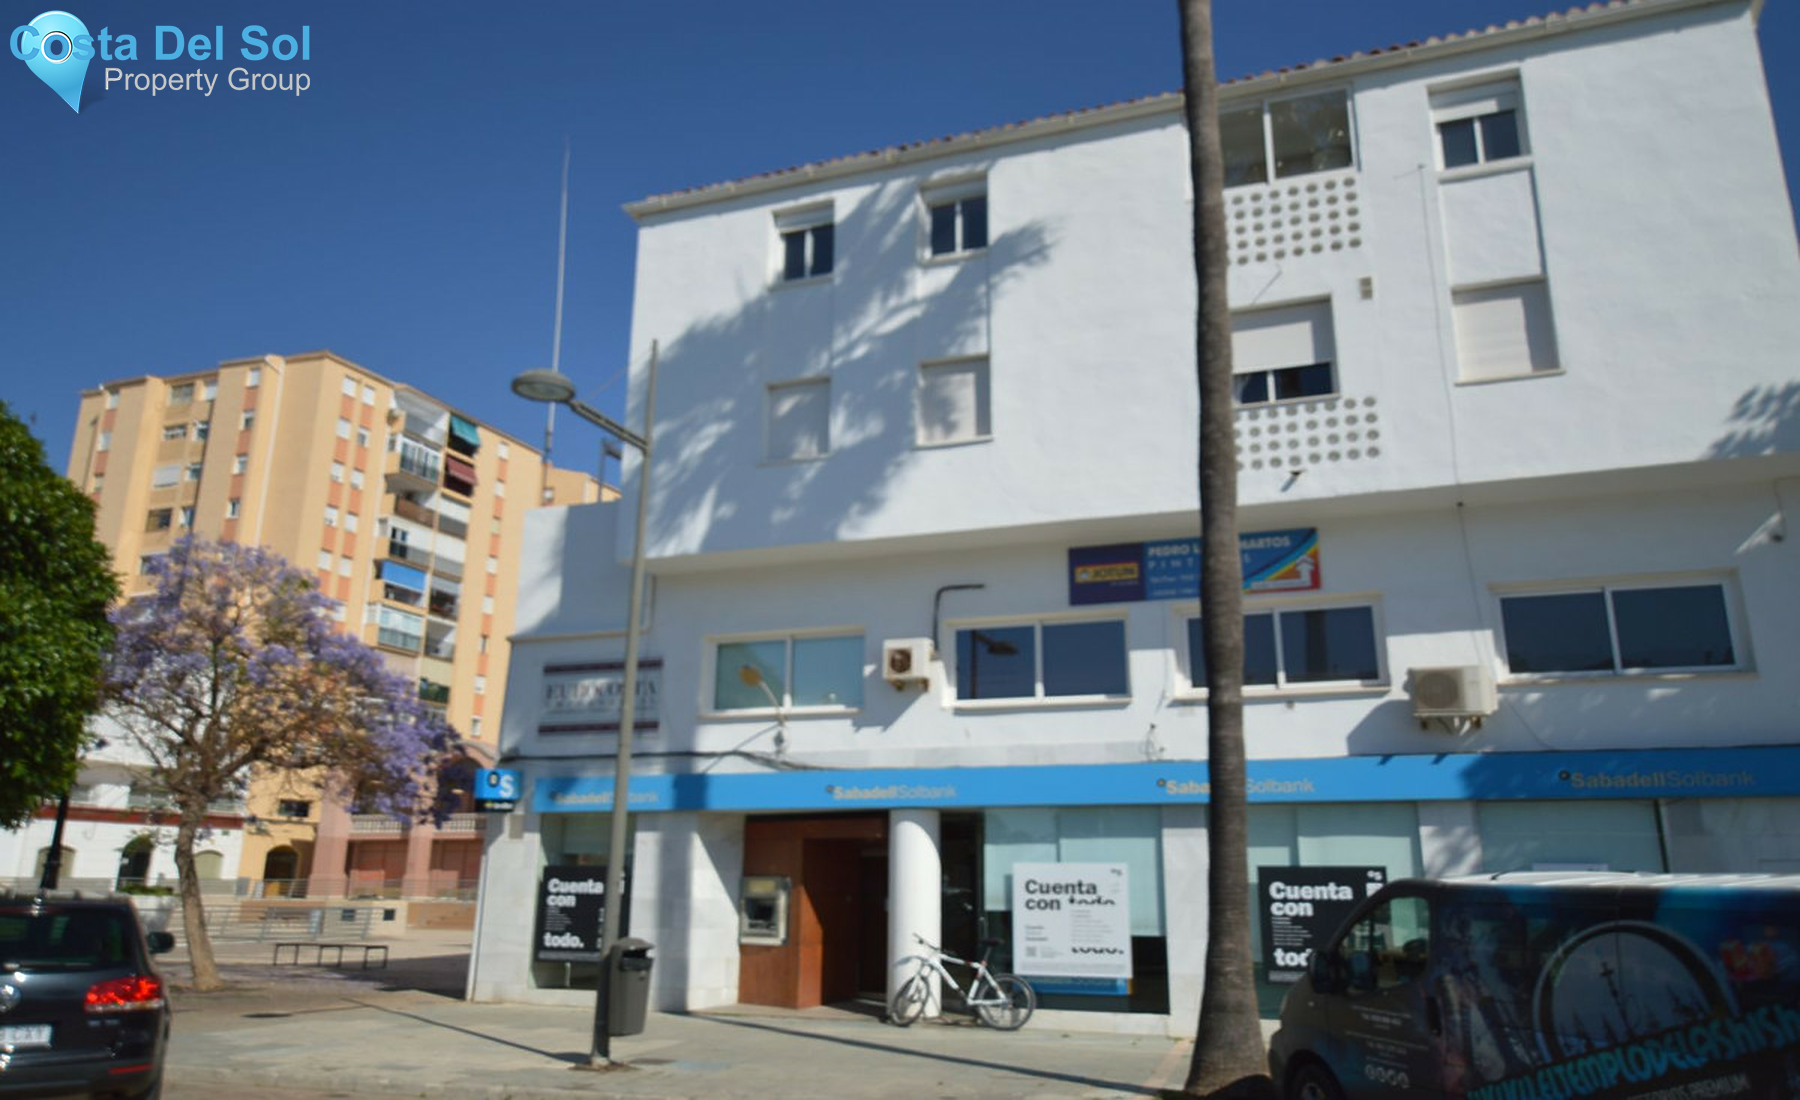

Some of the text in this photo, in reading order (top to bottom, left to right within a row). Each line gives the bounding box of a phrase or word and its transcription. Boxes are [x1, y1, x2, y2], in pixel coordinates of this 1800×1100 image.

[1166, 778, 1314, 795] SabaSolbank
[547, 878, 604, 894] Cuenta
[1025, 879, 1098, 895] Cuenta
[1269, 881, 1353, 900] Cuenta
[546, 895, 577, 908] con
[1025, 897, 1061, 911] con
[1270, 902, 1314, 917] con
[543, 931, 585, 949] todo.
